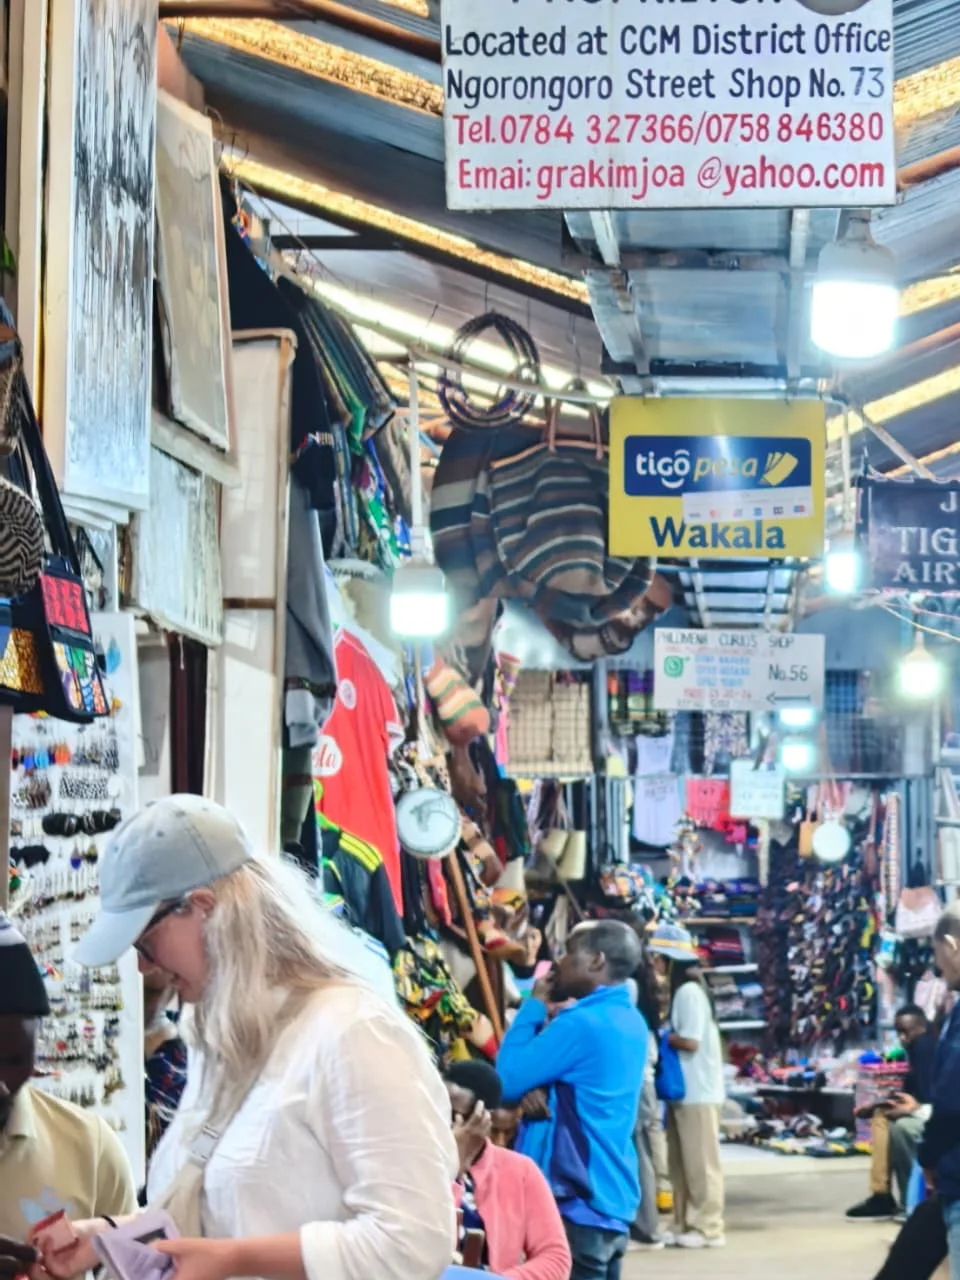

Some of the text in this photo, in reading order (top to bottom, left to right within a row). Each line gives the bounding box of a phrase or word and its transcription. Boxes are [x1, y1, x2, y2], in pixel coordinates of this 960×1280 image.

[446, 24, 891, 56] Located at CCM District Office
[446, 69, 613, 110] Ngorongoro
[625, 67, 716, 99] Street
[729, 68, 801, 107] Shop
[587, 110, 770, 146] 327366/0758
[777, 112, 884, 142] 846380
[697, 156, 884, 196] @yahoo.com
[636, 449, 757, 488] tigo pesa
[649, 516, 786, 550] Wakala
[768, 663, 809, 682] No.56
